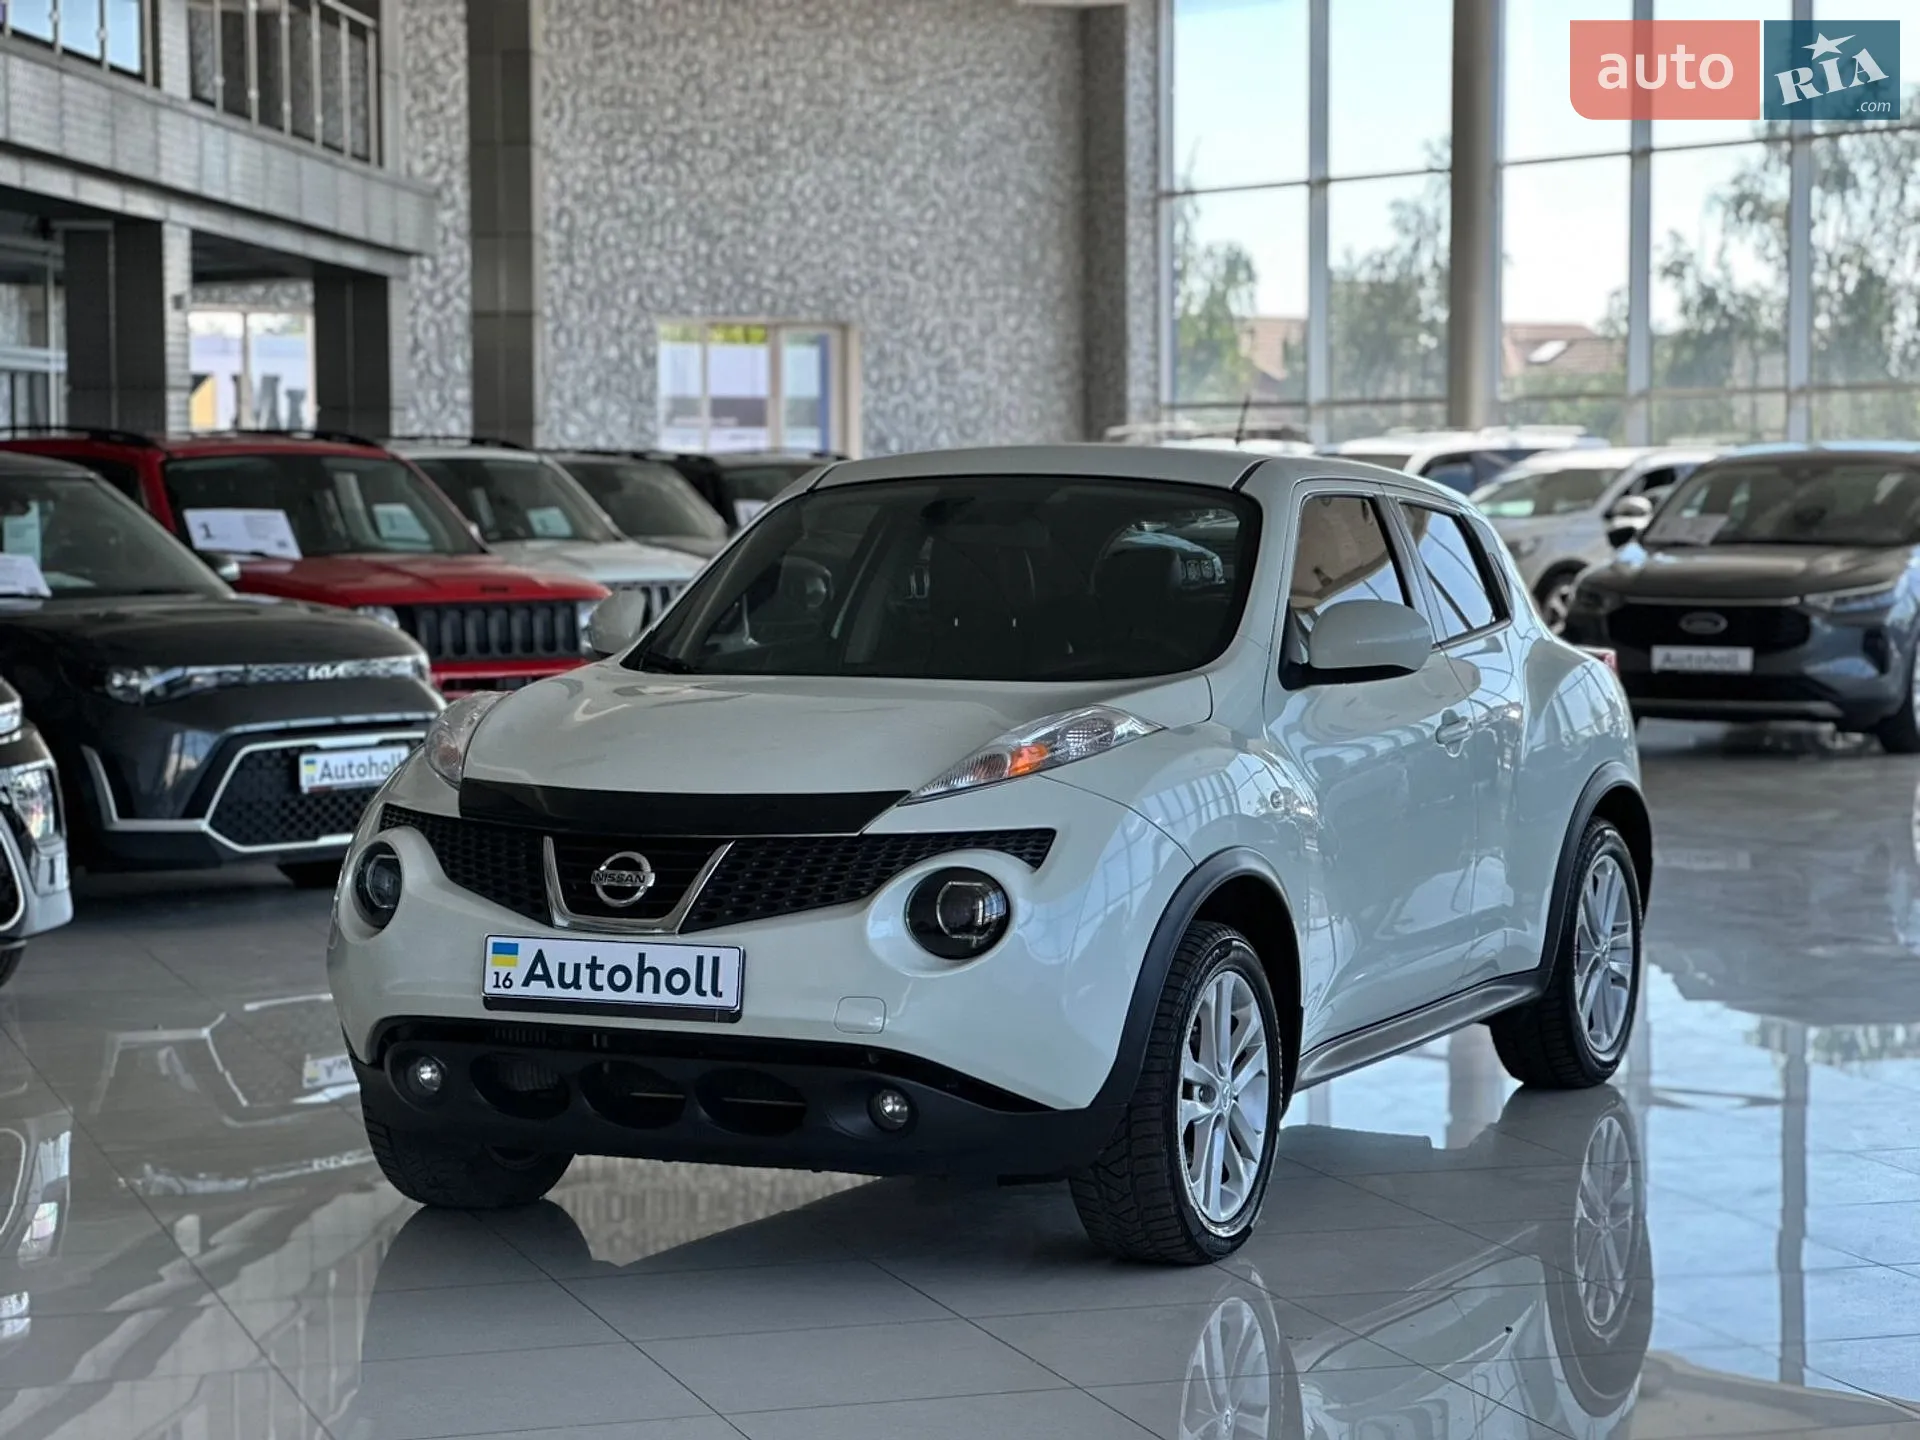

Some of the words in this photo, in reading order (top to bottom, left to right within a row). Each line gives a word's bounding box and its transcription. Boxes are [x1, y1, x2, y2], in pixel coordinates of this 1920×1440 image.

[593, 872, 646, 884] NISSAN
[492, 971, 514, 989] 16
[521, 948, 723, 998] Autoholl
